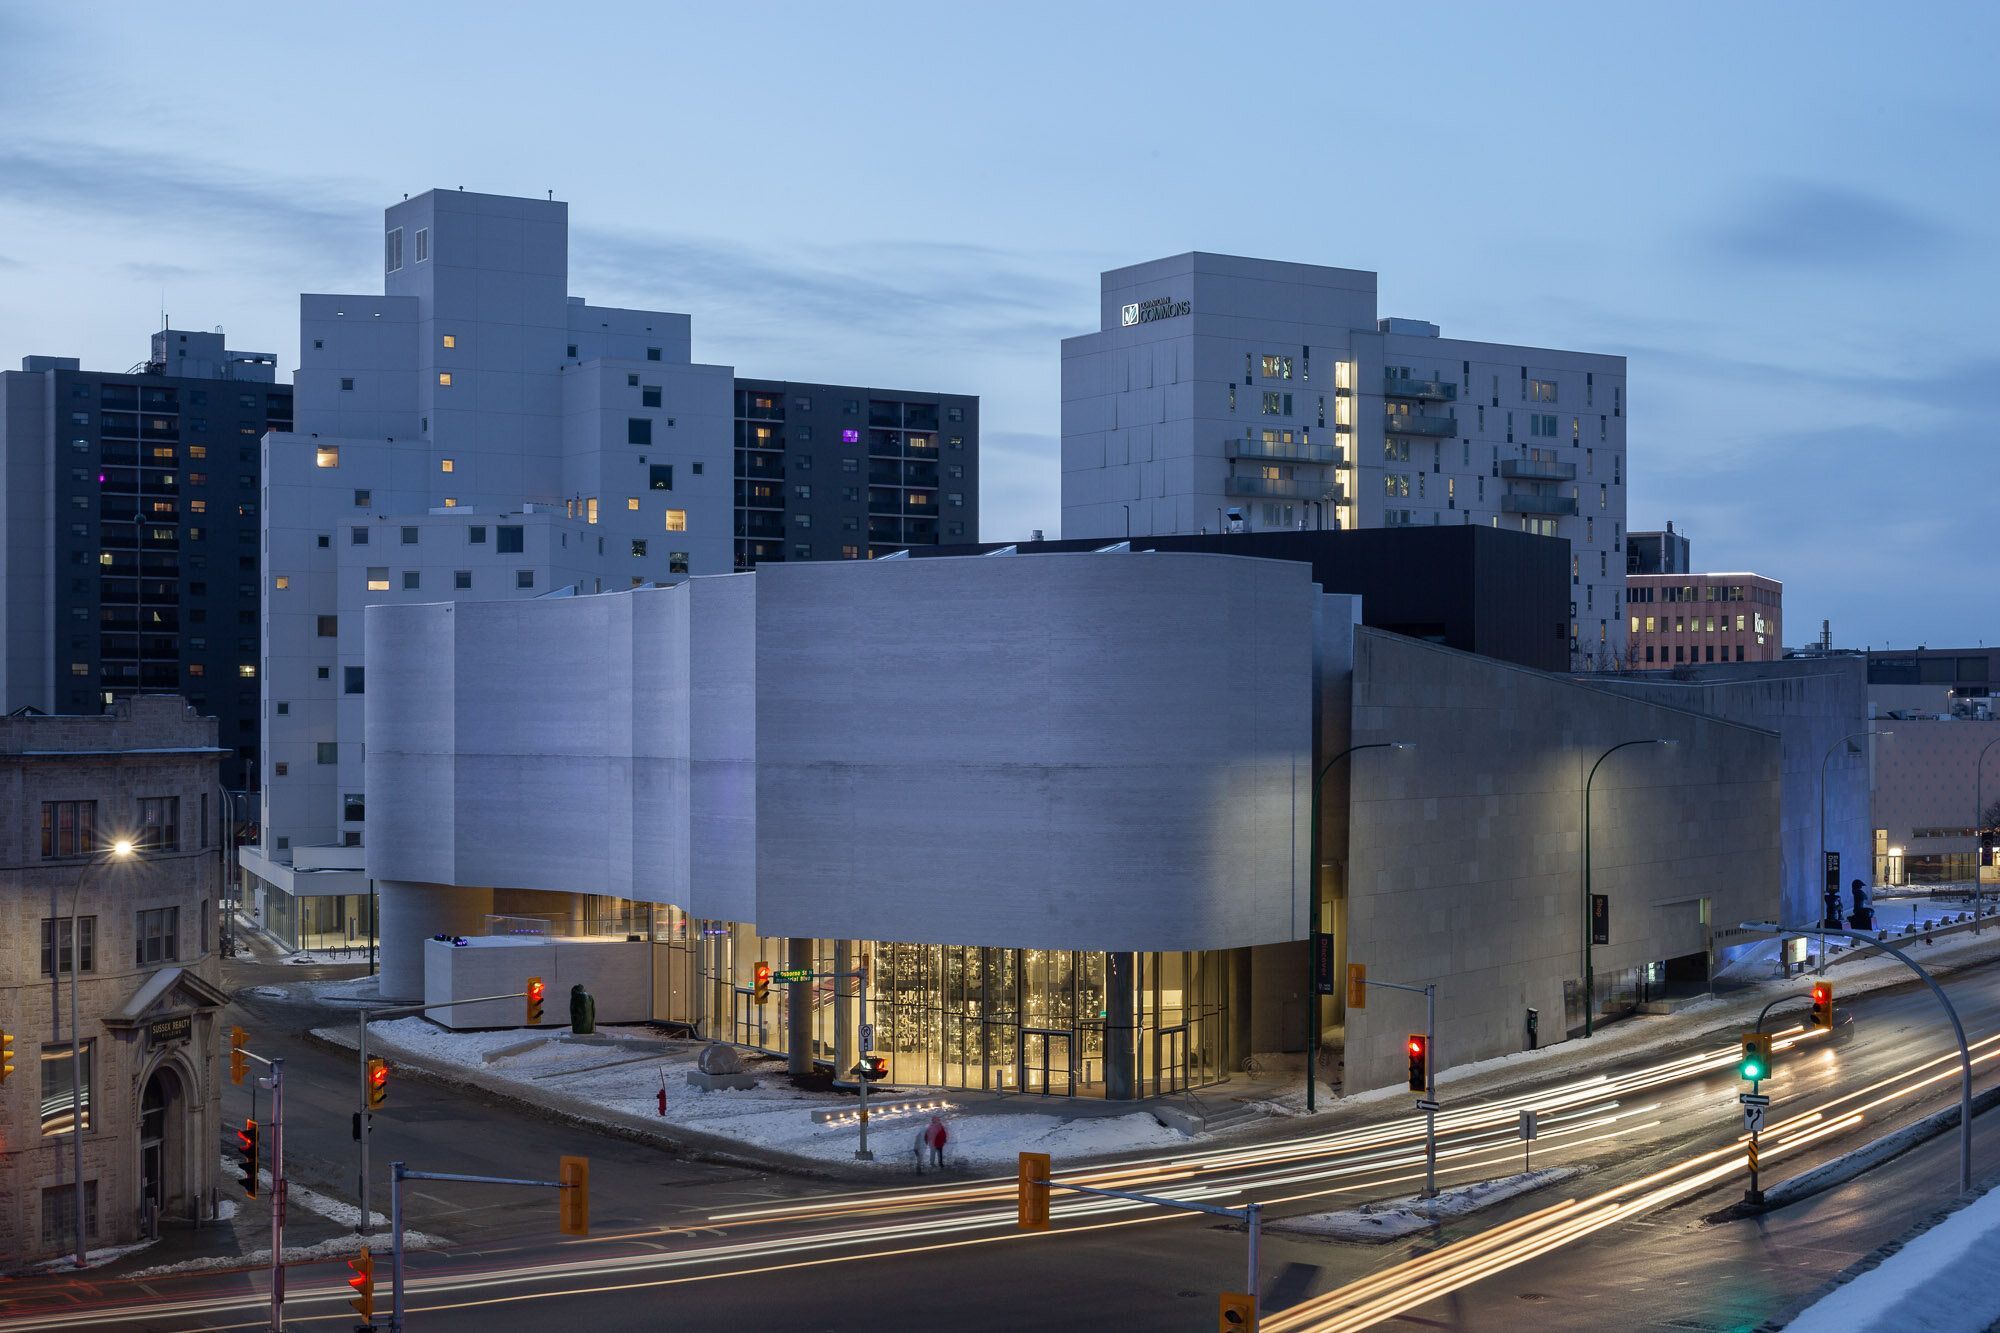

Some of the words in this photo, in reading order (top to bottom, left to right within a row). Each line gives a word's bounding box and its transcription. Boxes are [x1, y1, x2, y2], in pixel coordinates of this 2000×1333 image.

[1140, 301, 1191, 323] COMMONS
[1595, 898, 1603, 917] Shop
[152, 1023, 171, 1034] SUSSEX
[172, 1019, 191, 1030] REALTY
